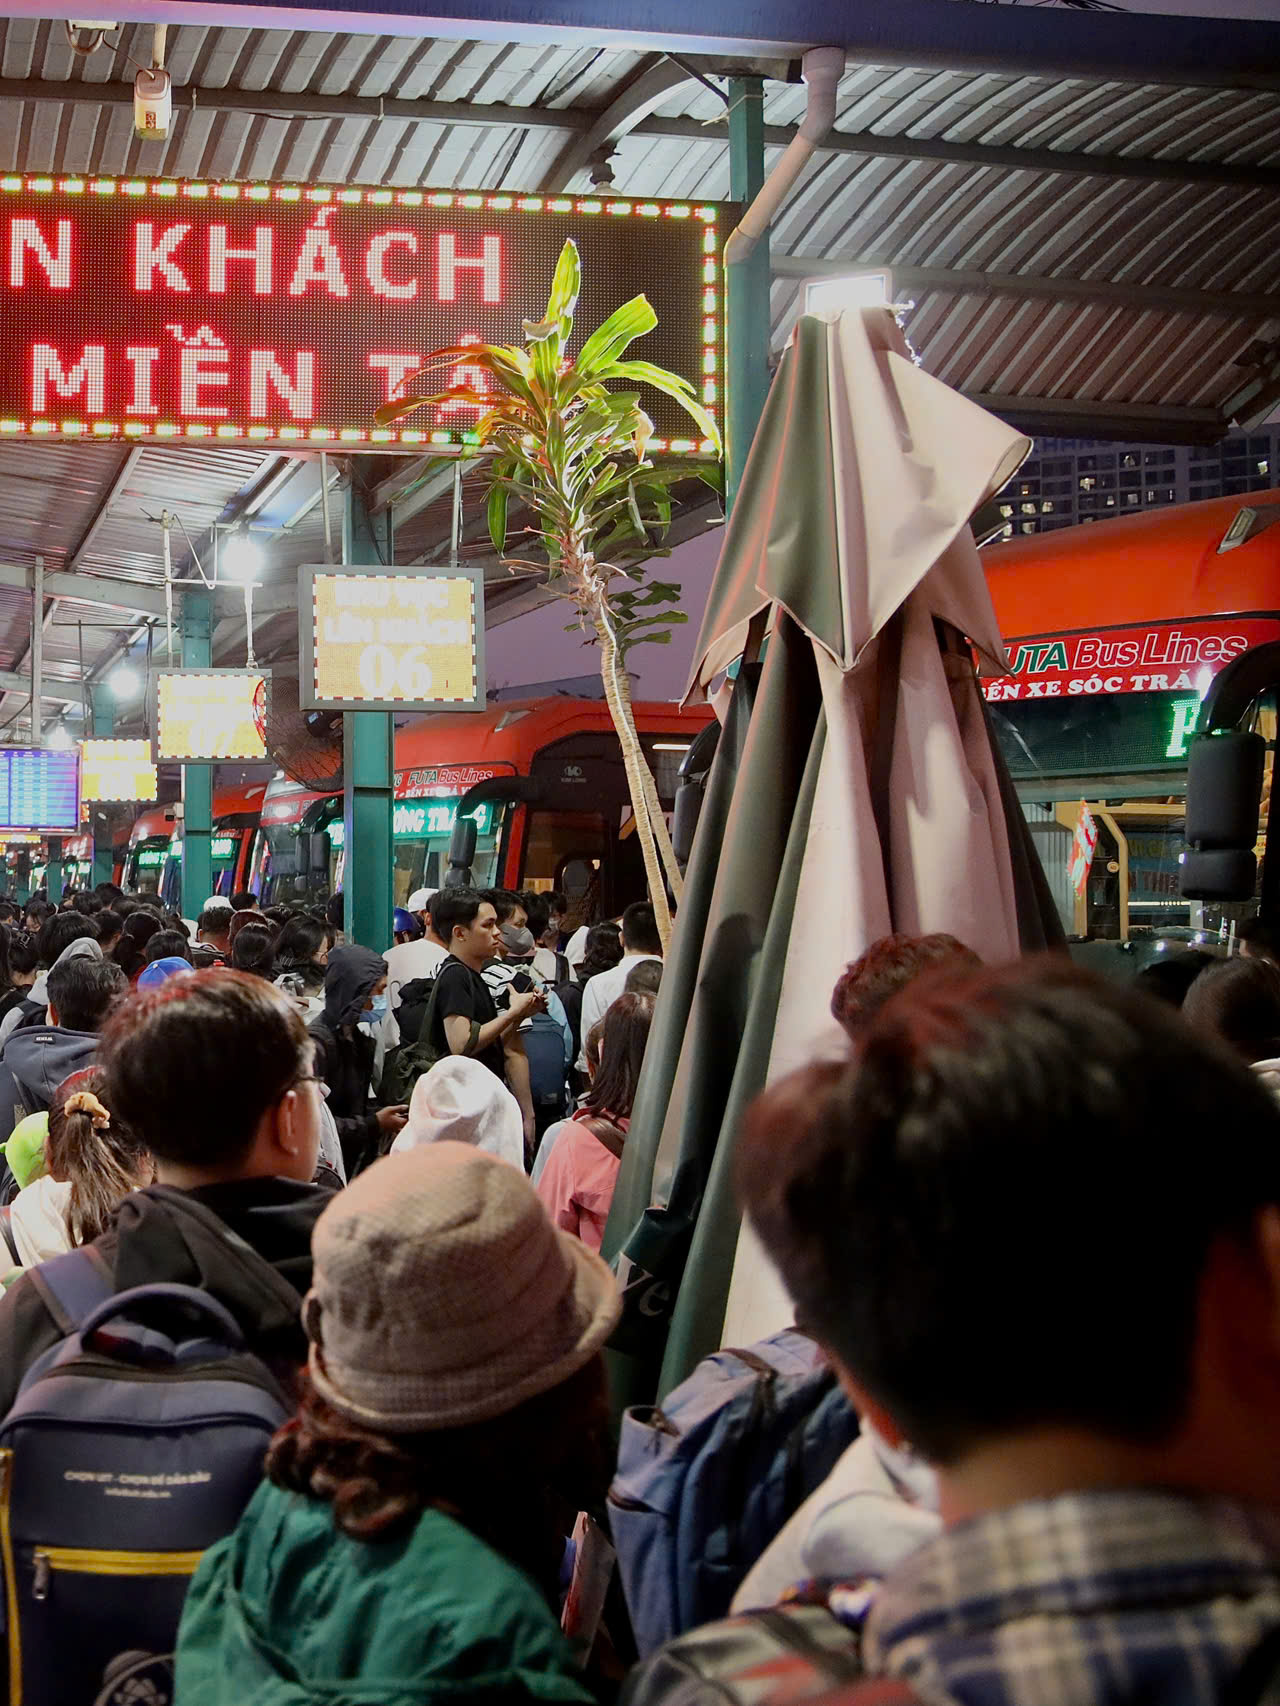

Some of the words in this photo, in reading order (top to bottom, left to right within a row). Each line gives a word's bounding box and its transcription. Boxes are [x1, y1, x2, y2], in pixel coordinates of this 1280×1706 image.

[134, 207, 504, 303] KHÁCH
[31, 324, 314, 420] MIỀN
[359, 645, 432, 697] 06
[1005, 642, 1069, 674] UTA
[1073, 638, 1138, 670] Bus
[1141, 632, 1248, 666] Lines
[1025, 680, 1061, 699] XE
[1070, 673, 1123, 694] SÓC
[408, 770, 438, 786] FUTA
